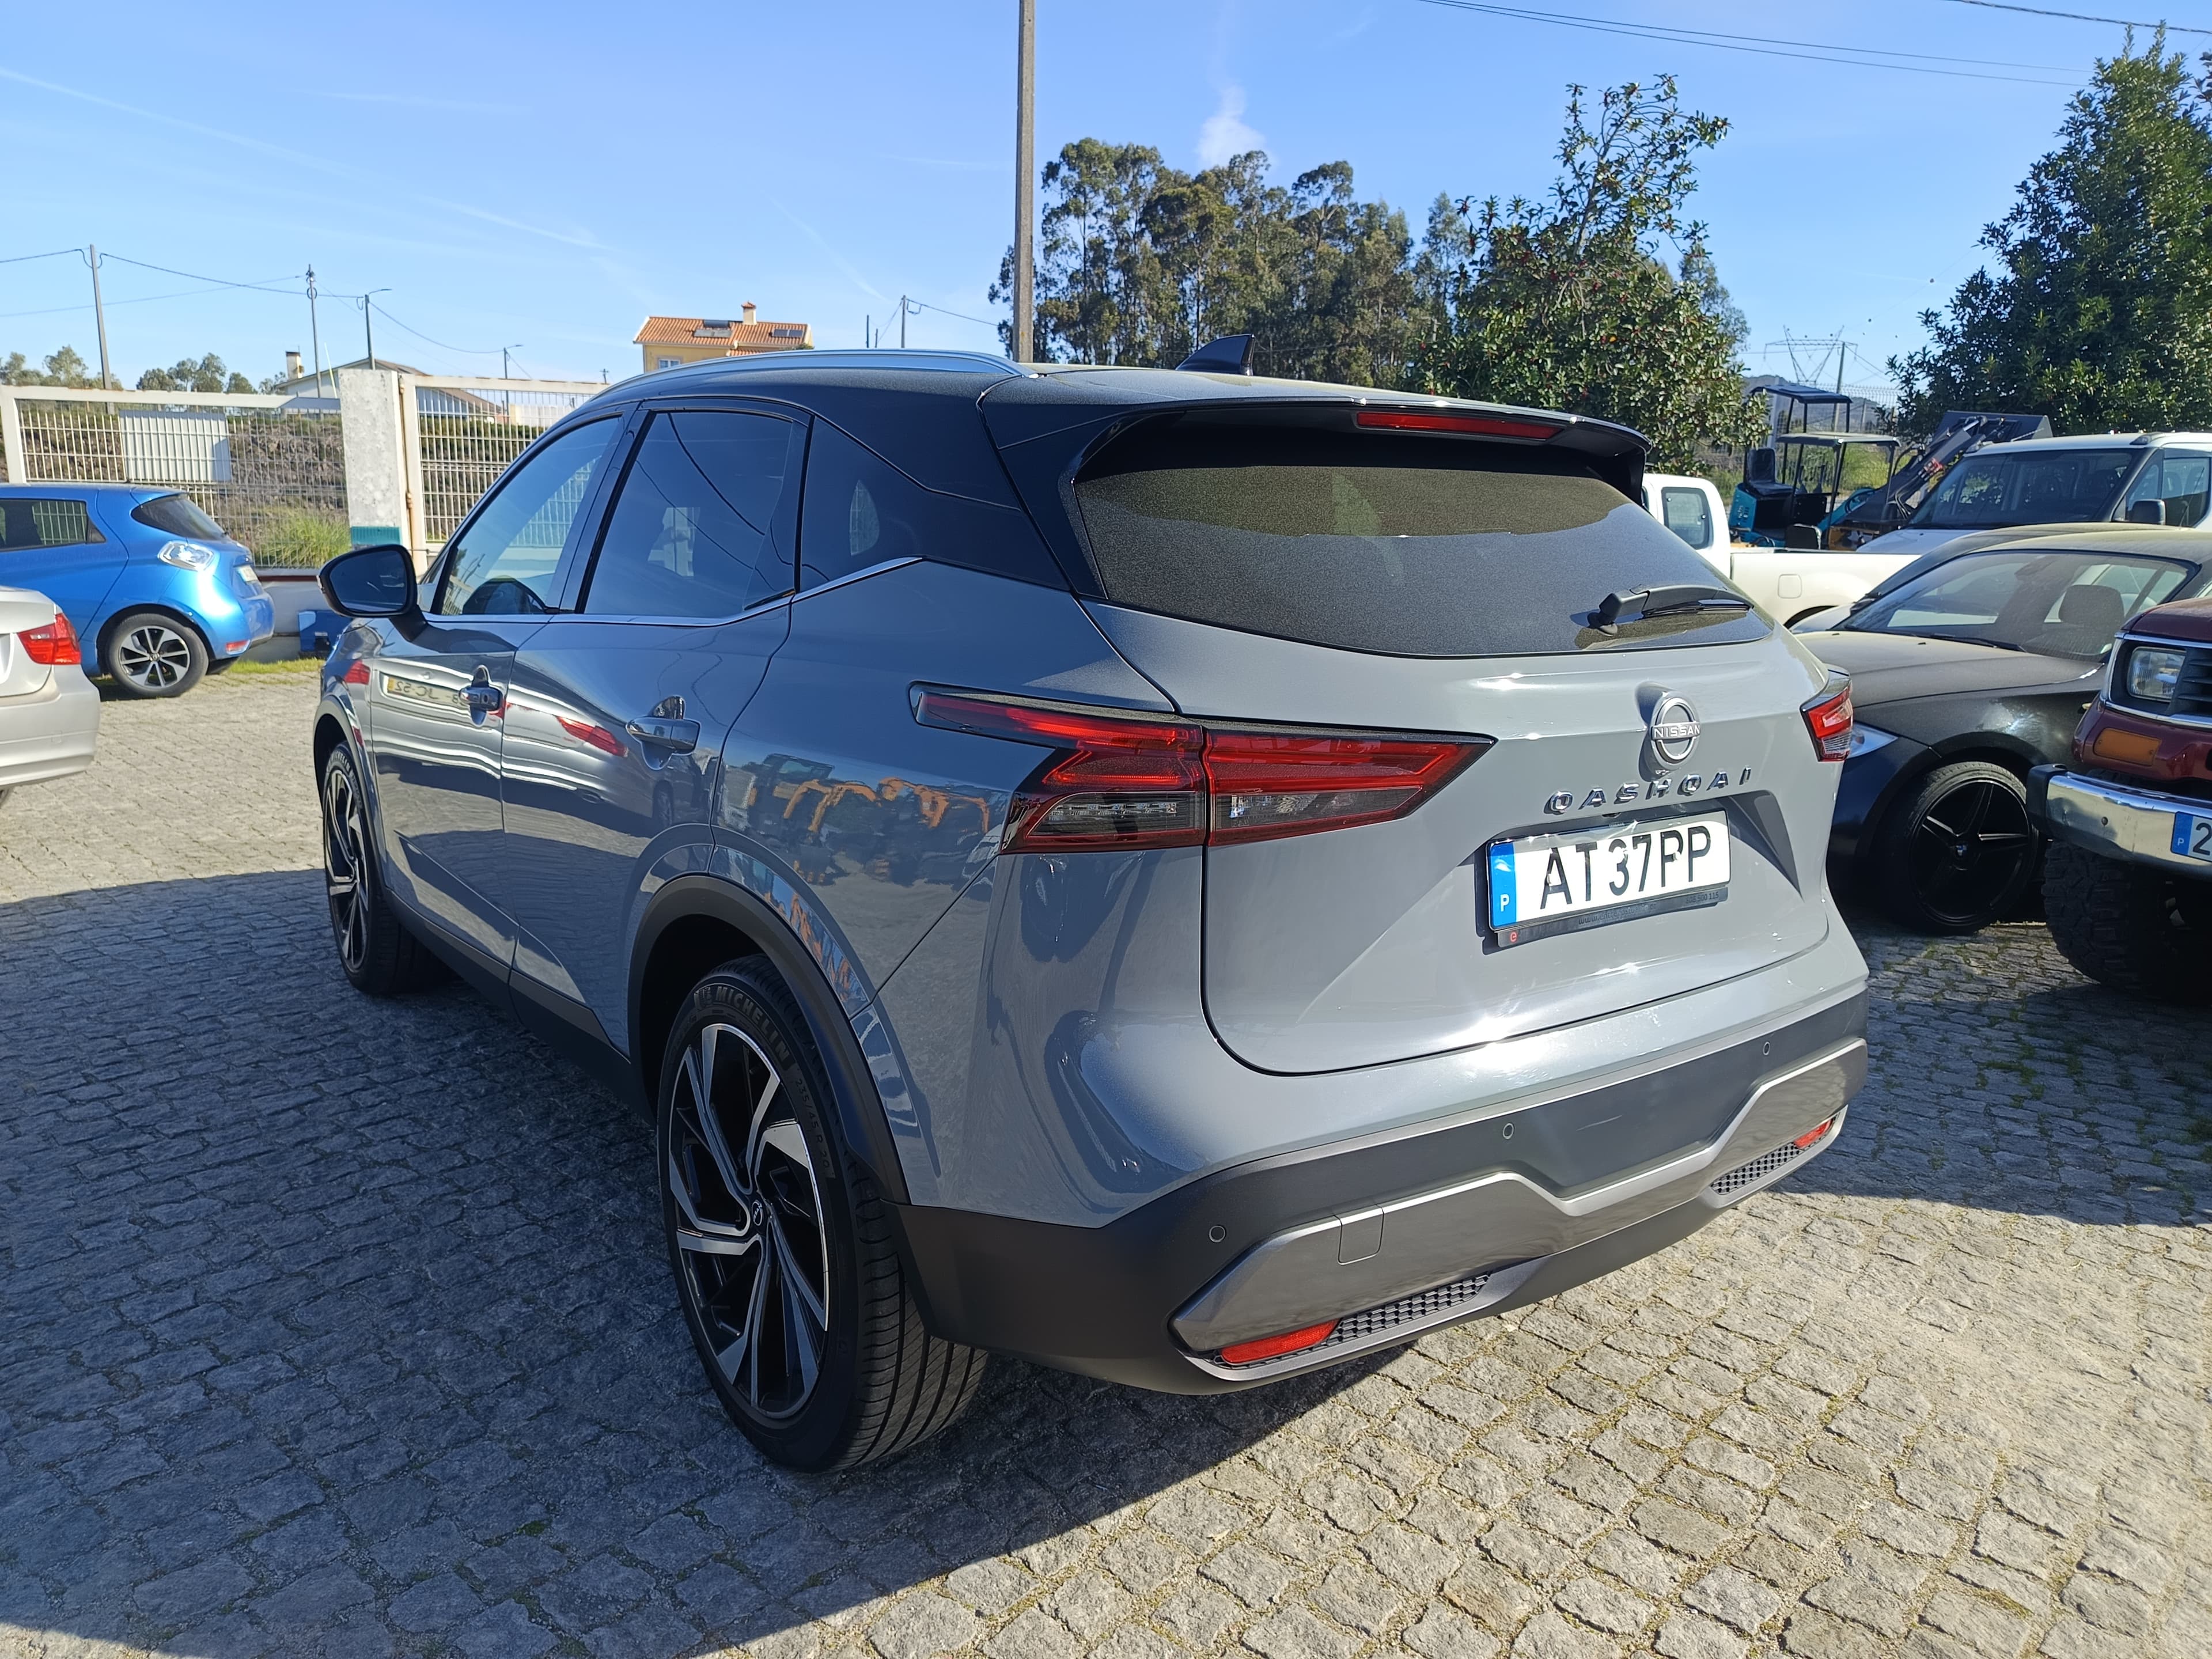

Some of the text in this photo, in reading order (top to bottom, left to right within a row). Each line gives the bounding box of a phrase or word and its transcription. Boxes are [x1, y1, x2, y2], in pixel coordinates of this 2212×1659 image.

[1654, 725, 1700, 738] NISSAN
[1548, 765, 1752, 813] QASHQAI
[2177, 838, 2184, 846] P
[1500, 894, 1510, 912] P
[715, 986, 790, 1060] MICHELIN
[796, 1078, 819, 1130] 235/45
